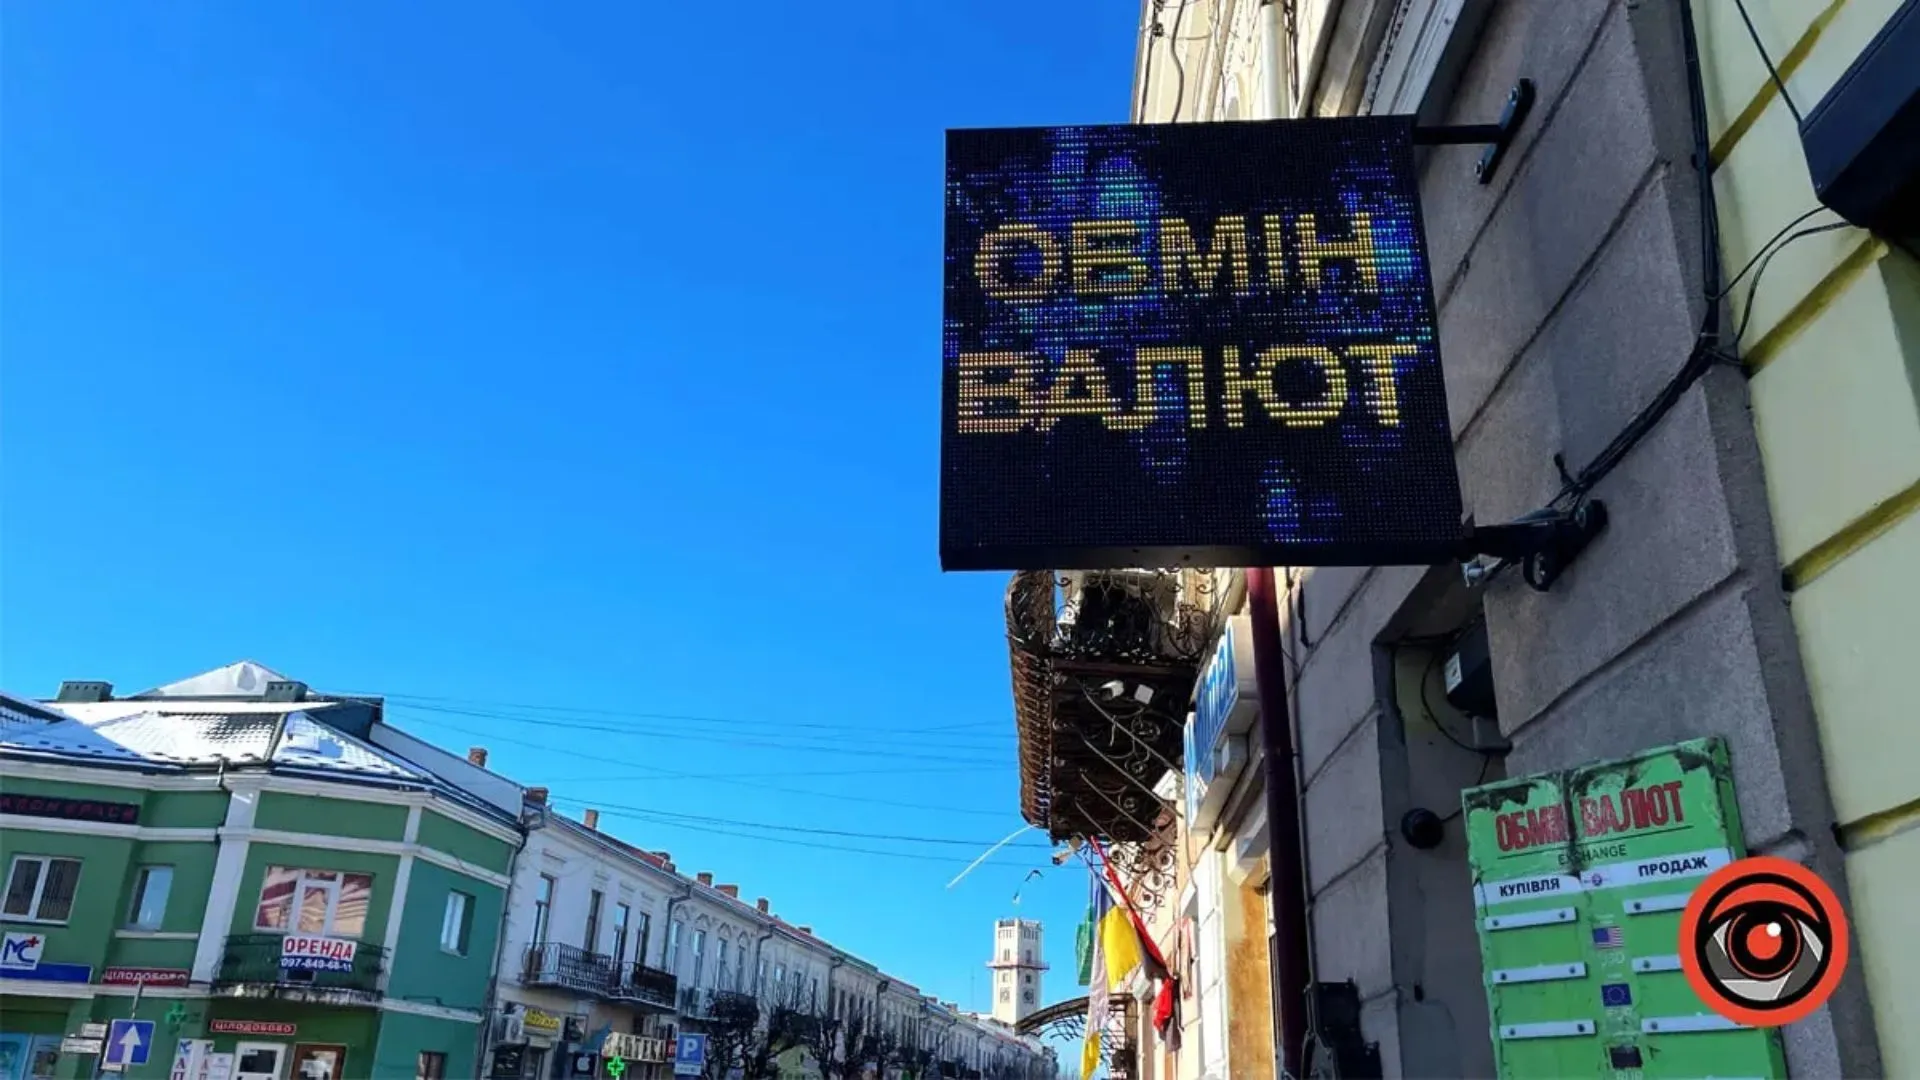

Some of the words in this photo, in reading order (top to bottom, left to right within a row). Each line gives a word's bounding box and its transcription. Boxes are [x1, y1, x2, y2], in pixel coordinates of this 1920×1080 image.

[973, 211, 1382, 302] ОБМІН
[957, 344, 1418, 433] ВАЛЮТ
[1579, 781, 1684, 837] ВАЛЮТ
[1500, 877, 1560, 898] КУПІВЛЯ
[1638, 856, 1708, 878] ПРОДАЖ
[285, 938, 353, 959] ОРЕНДА
[683, 1038, 698, 1058] P
